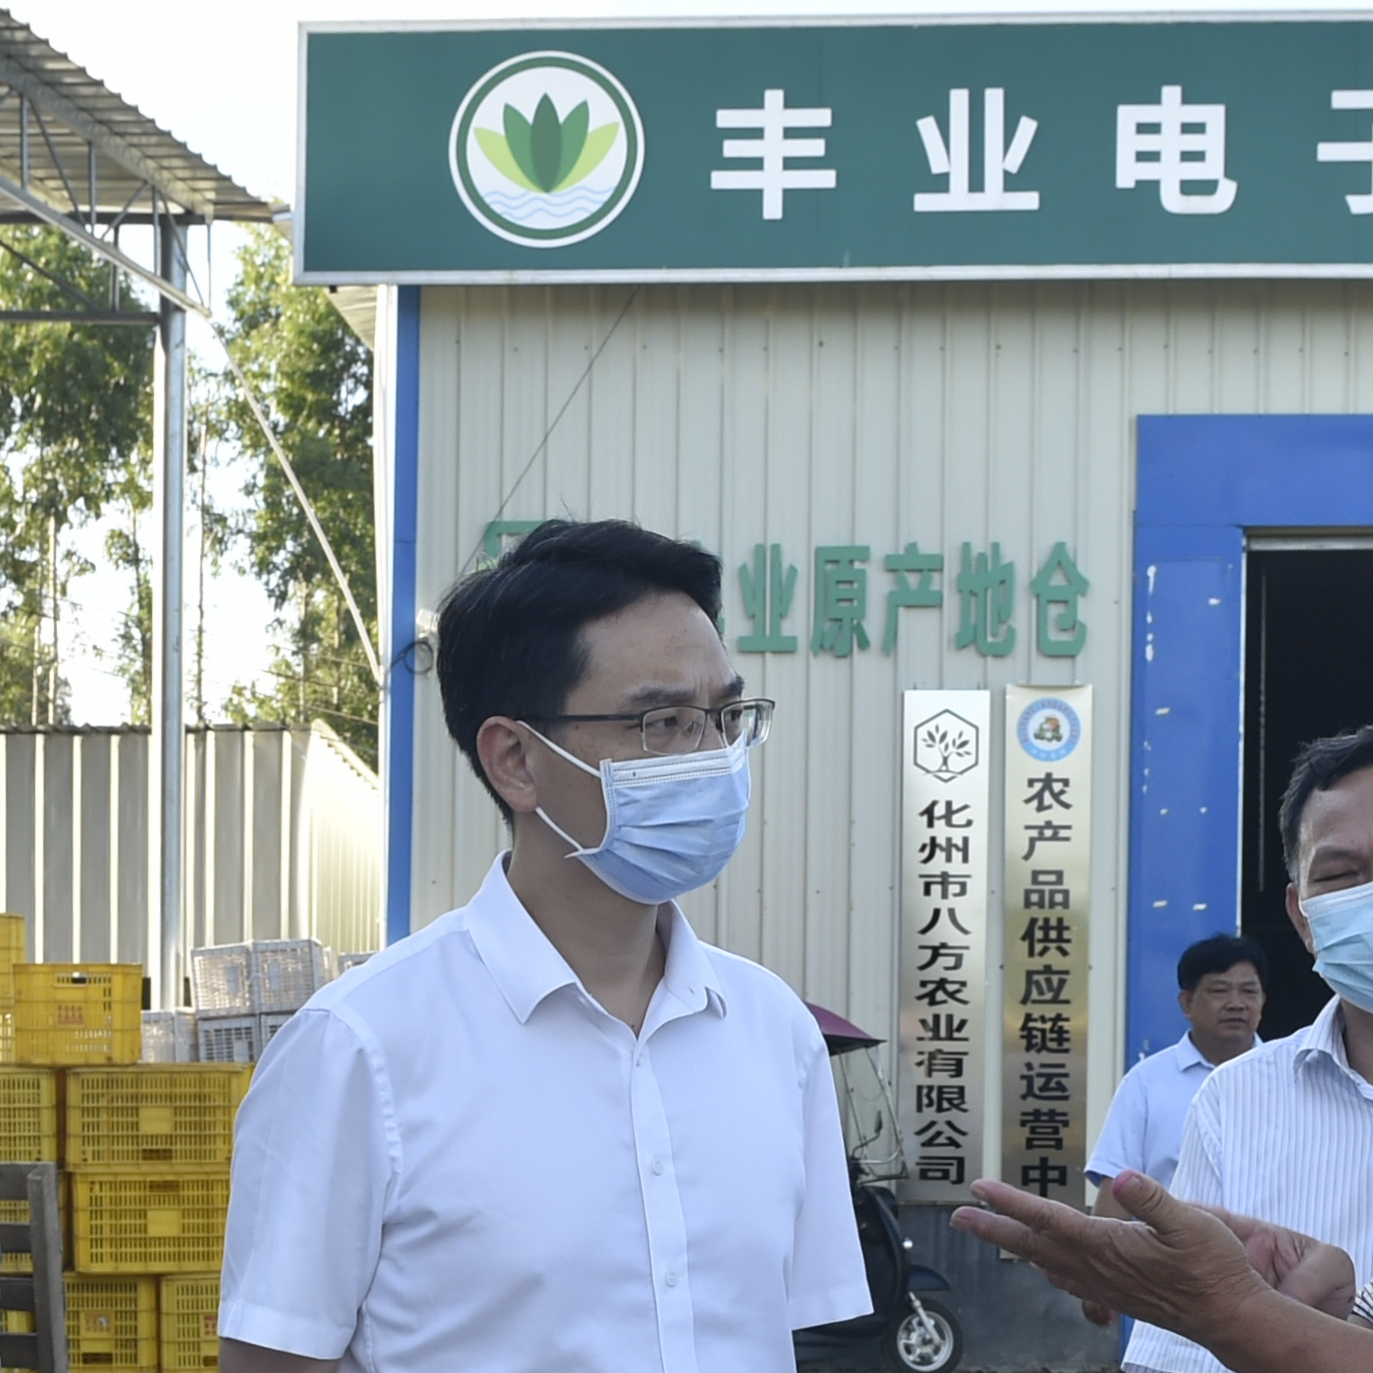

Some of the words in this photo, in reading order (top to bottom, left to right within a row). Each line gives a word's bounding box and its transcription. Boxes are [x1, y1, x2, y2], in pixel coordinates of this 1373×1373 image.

[721, 542, 1089, 657] 业原产地仓
[913, 800, 974, 1185] 化州市八方农业有限公司
